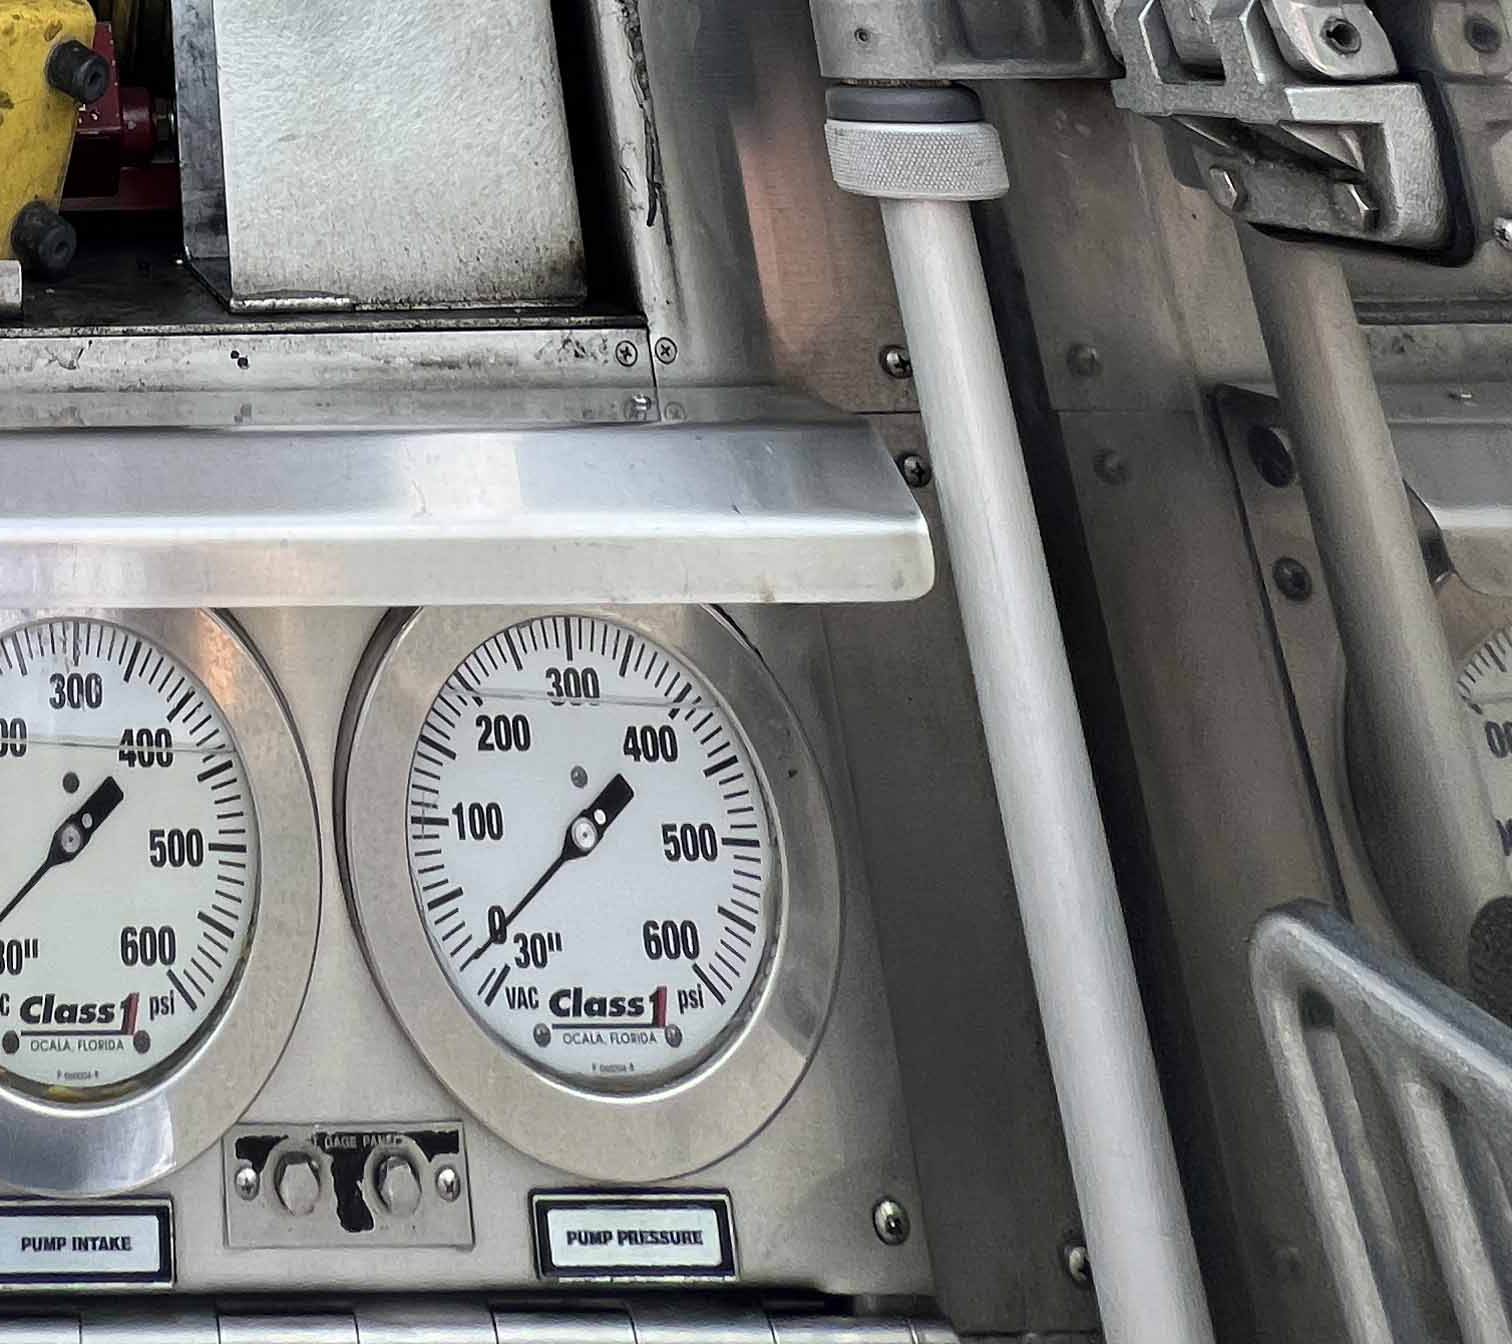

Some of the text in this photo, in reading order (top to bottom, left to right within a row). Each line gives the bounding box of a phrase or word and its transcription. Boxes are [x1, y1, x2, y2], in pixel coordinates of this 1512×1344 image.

[49, 673, 103, 709] 300
[545, 667, 600, 706] 300
[118, 728, 173, 767] 400
[475, 714, 530, 752] 200
[623, 725, 678, 762] 400
[452, 802, 504, 840] 100
[149, 828, 204, 868] 500
[661, 823, 718, 862] 500
[488, 906, 507, 944] 0
[642, 919, 700, 960] 600
[120, 926, 176, 967] 600
[513, 932, 562, 969] 30"
[149, 990, 175, 1021] psi
[505, 986, 539, 1010] VAC
[678, 984, 704, 1014] psi
[78, 1039, 125, 1052] FLORIDA
[610, 1032, 657, 1045] FLORIDA
[21, 1236, 132, 1252] PUMP INTAKE
[566, 1230, 704, 1245] PUMP PRESSURE
